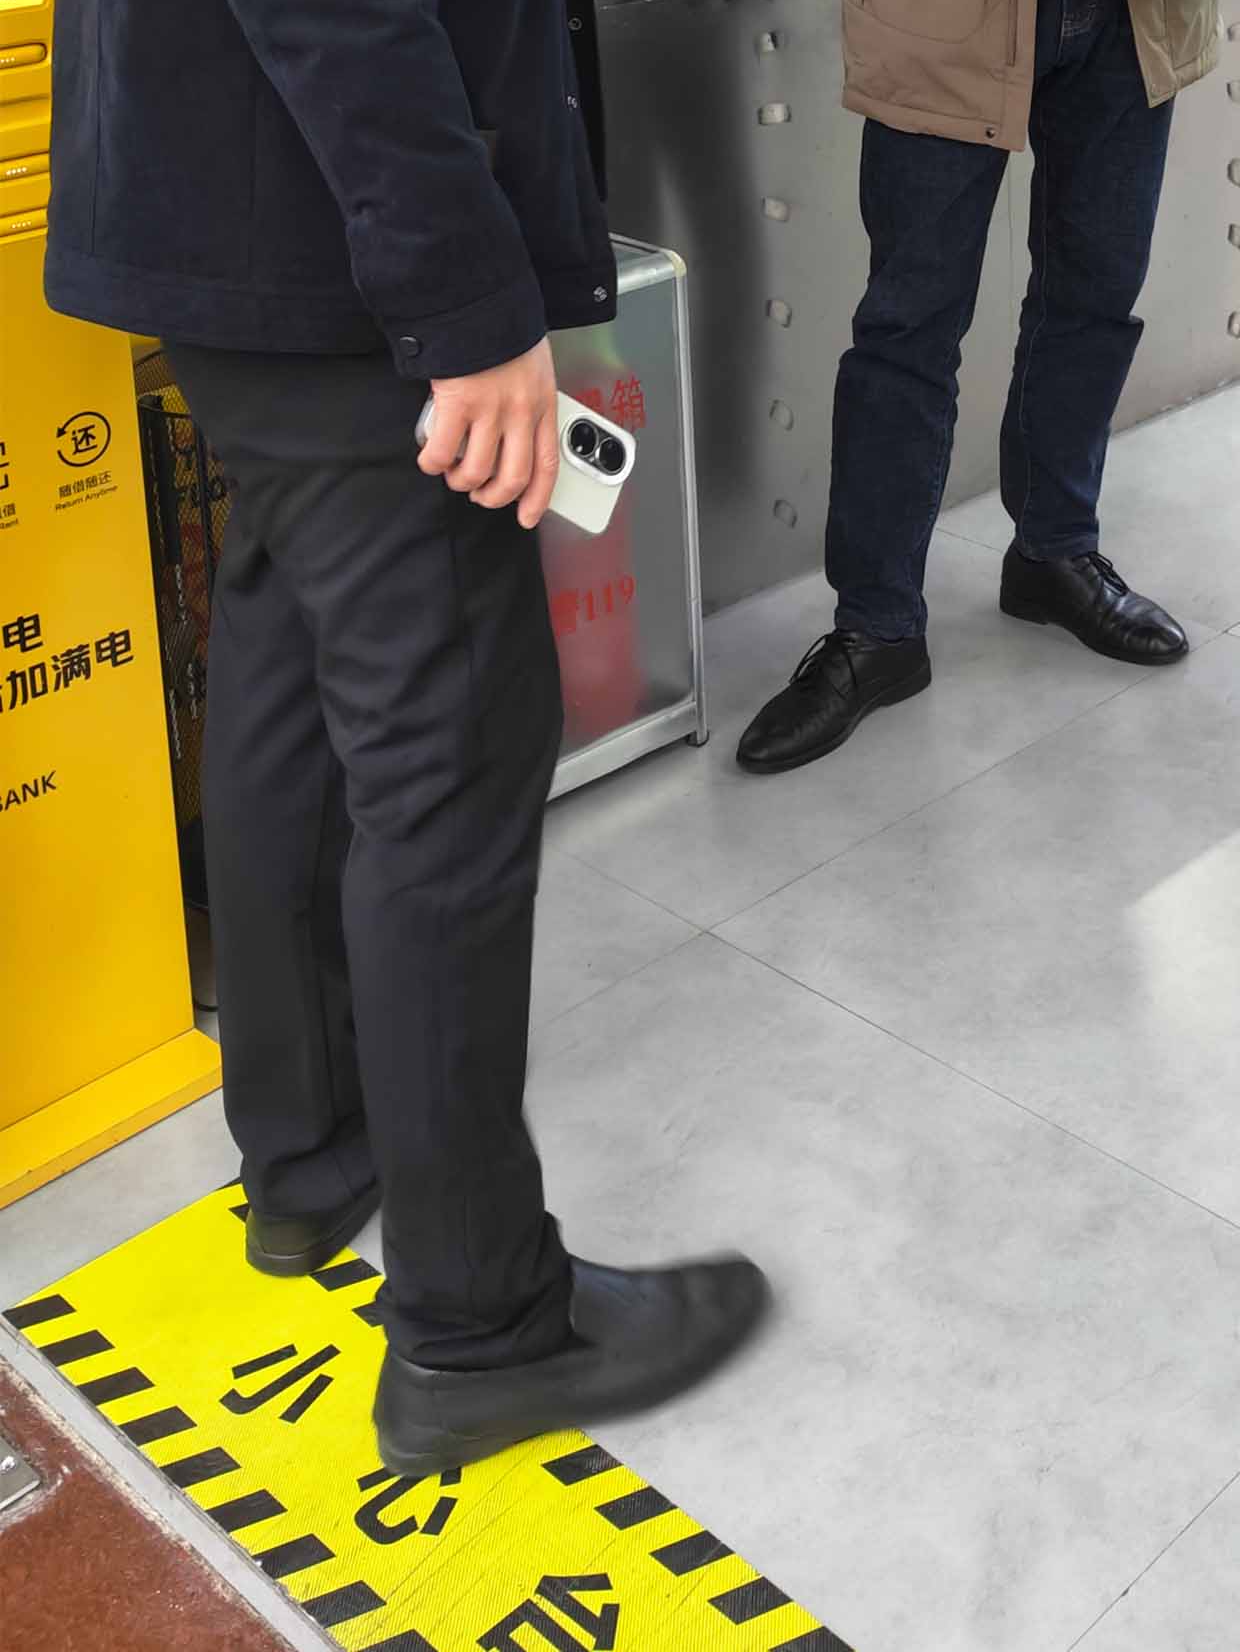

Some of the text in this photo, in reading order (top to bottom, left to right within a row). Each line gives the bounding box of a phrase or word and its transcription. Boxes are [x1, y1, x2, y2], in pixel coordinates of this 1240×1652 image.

[71, 423, 98, 456] 还
[58, 470, 113, 499] 随借随还
[2, 613, 44, 653] 电
[0, 629, 134, 714] 加满电
